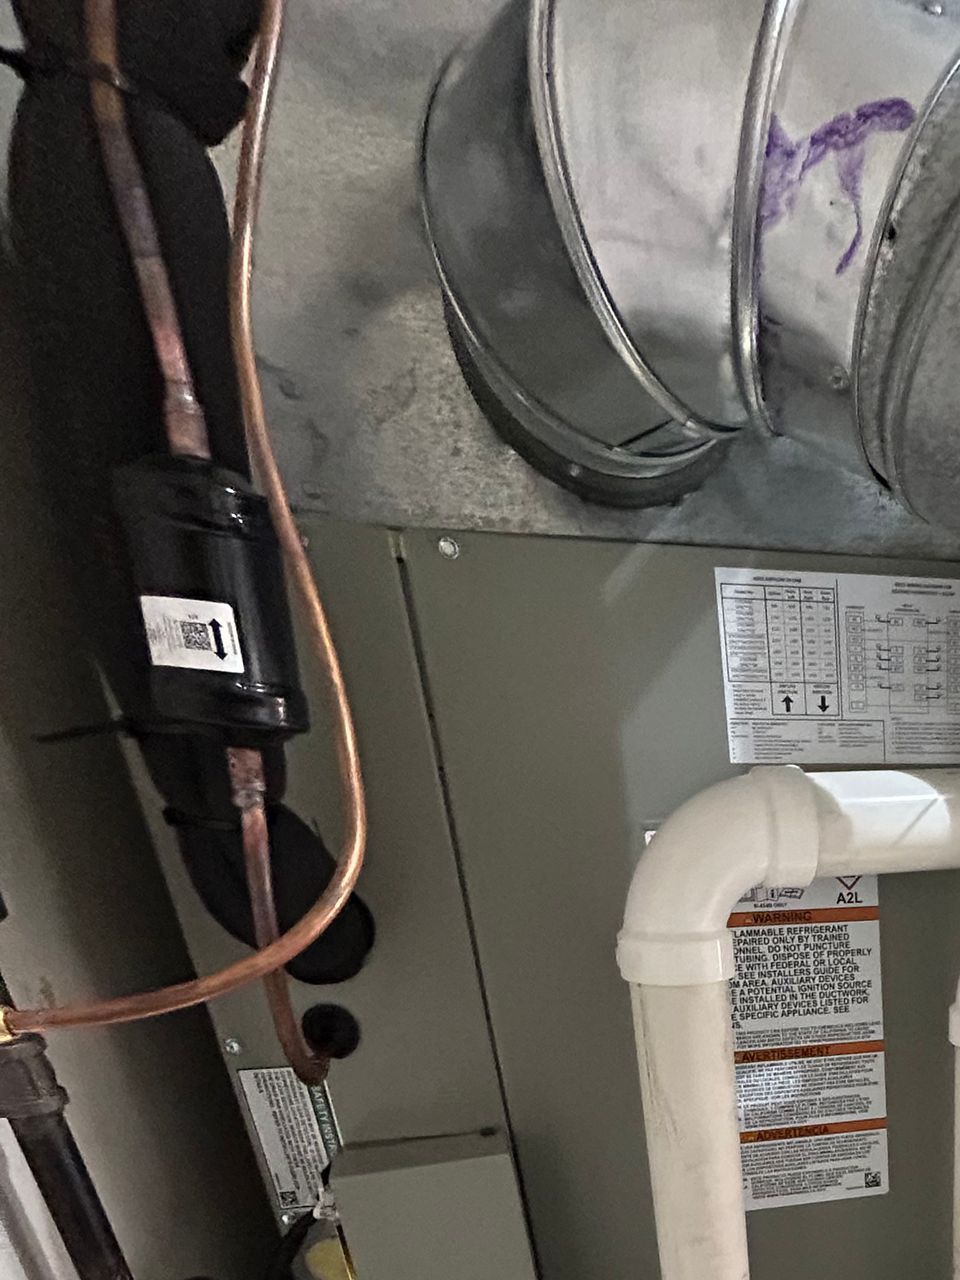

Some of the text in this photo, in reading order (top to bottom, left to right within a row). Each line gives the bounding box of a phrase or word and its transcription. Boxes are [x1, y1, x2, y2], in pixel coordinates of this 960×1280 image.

[836, 892, 863, 904] A2L
[752, 911, 812, 924] WARNING
[733, 924, 848, 938] LAMMABLE REFRIGERANT
[733, 933, 850, 946] EPAIRED ONLY BY TRAINED
[768, 945, 781, 953] DO
[783, 944, 801, 952] NOT
[804, 941, 851, 951] PUNCTURE
[772, 952, 810, 961] DISPOSE
[813, 951, 824, 959] OF
[827, 948, 872, 958] PROPERLY
[746, 963, 768, 971] WITH
[771, 960, 810, 969] FEDERAL
[813, 959, 826, 967] OR
[828, 958, 856, 966] LOCAL
[738, 972, 756, 980] SEE
[758, 968, 811, 978] INSTALLERS
[813, 967, 840, 975] GUIDE
[772, 976, 816, 986] AUXILIARY
[819, 974, 855, 982] DEVICES
[748, 986, 796, 995] POTENTIAL
[798, 983, 835, 992] IGNITION
[837, 980, 872, 990] SOURCE
[734, 996, 868, 1012] AUXILIARY DEVICES LISTED FOR
[740, 994, 787, 1004] INSTALLED
[800, 992, 816, 1000] THE
[739, 1011, 779, 1020] SPECIFIC
[833, 1006, 850, 1014] SEE
[742, 1046, 830, 1060] AVERTISSEMENT
[311, 1085, 329, 1123] SAFETY
[756, 1126, 829, 1140] ADVERTENCIA
